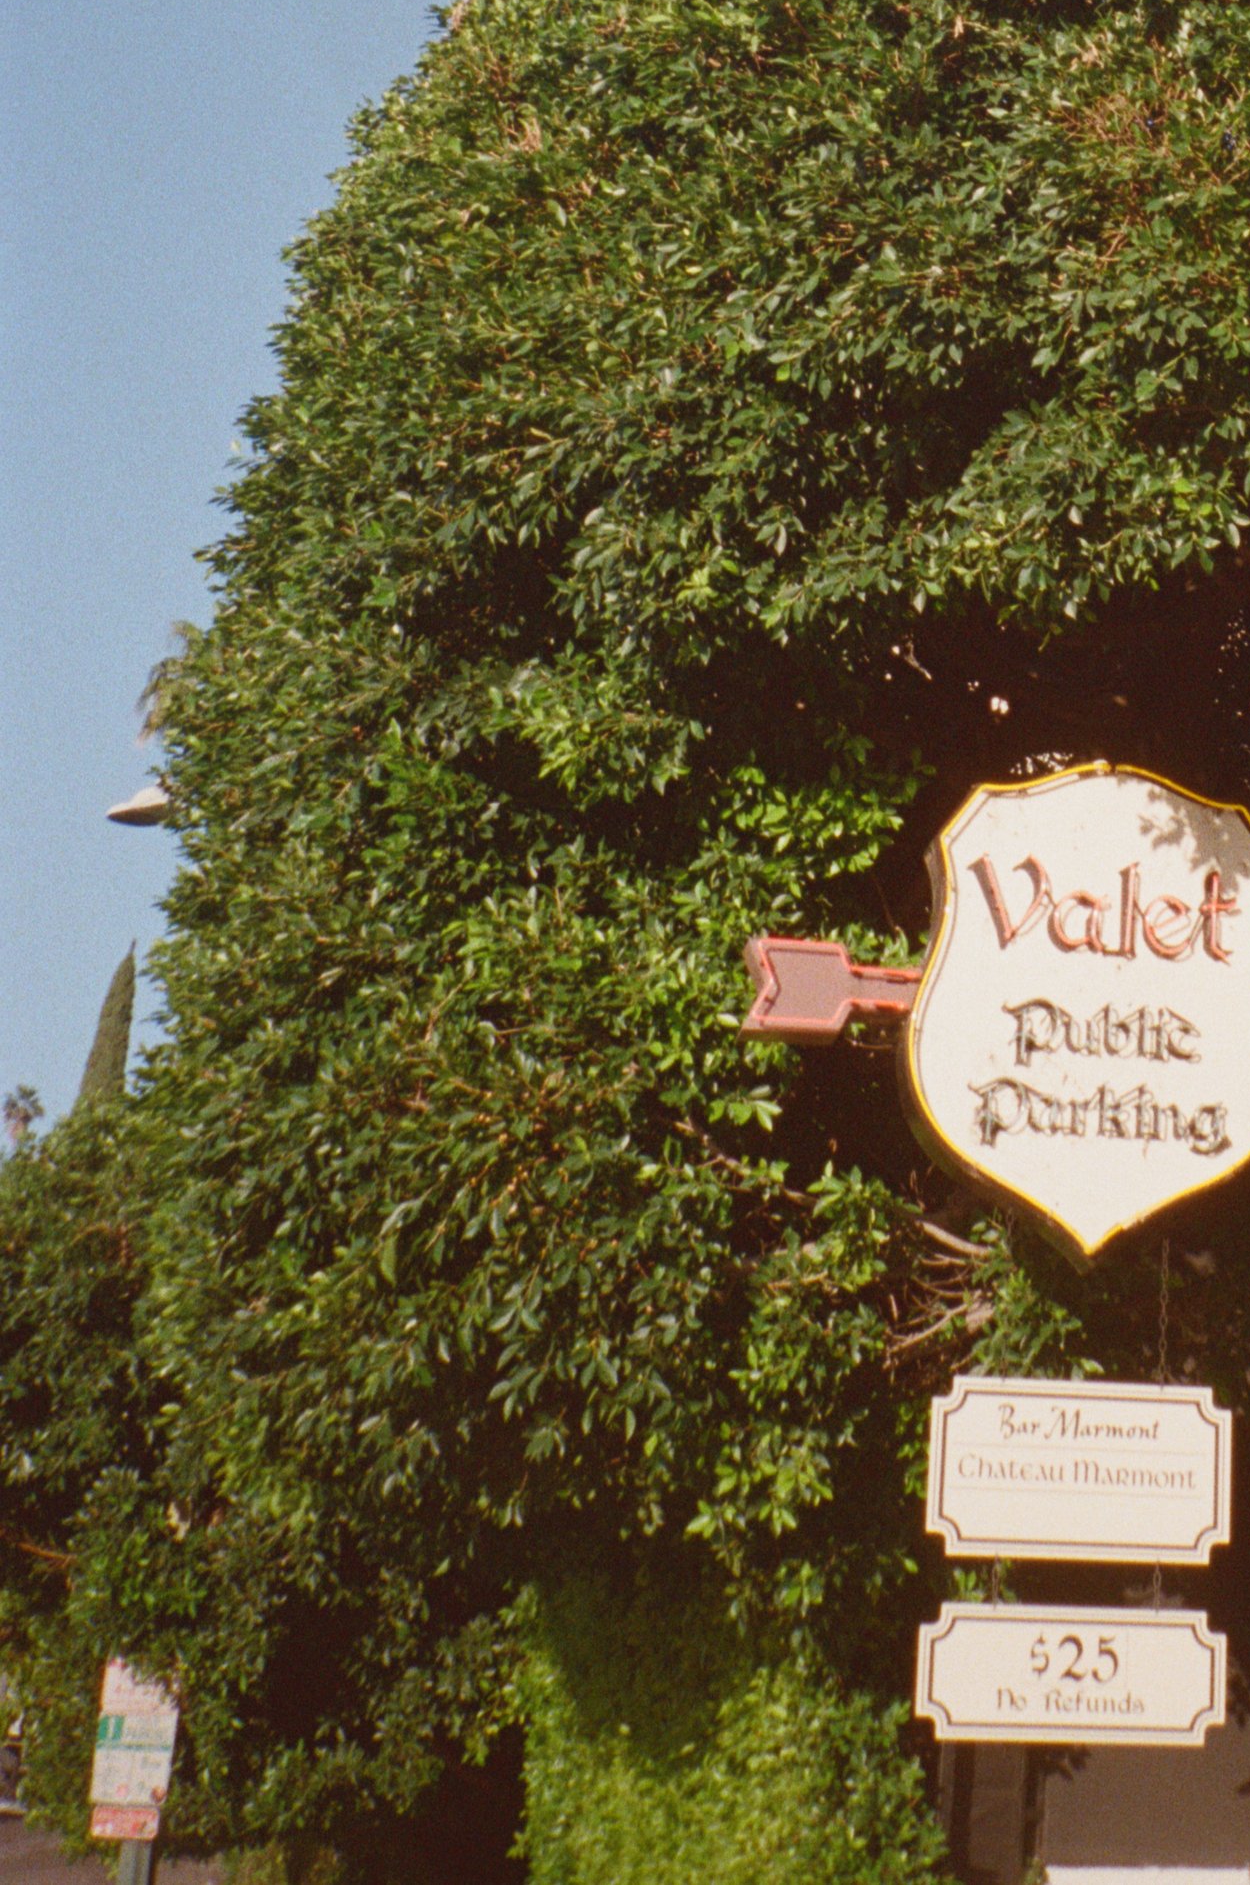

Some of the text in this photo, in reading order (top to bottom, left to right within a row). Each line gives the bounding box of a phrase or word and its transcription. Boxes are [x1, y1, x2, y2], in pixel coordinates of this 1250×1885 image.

[967, 852, 1241, 966] Valet
[1001, 998, 1202, 1066] Public
[967, 1076, 1233, 1156] Parking
[998, 1402, 1160, 1441] Bar Marmont
[957, 1453, 1197, 1490] Chateau Marmont
[1030, 1631, 1119, 1684] $25
[996, 1686, 1146, 1714] No Refunds
